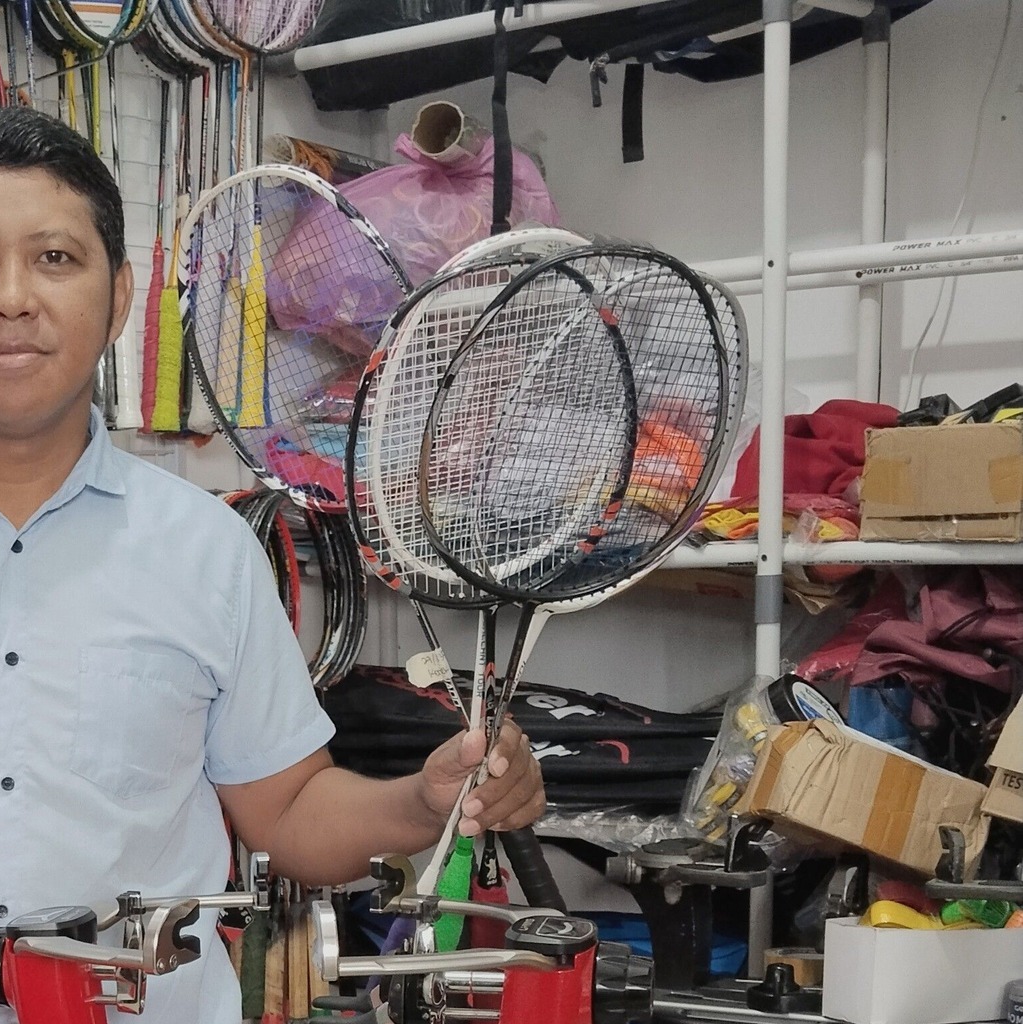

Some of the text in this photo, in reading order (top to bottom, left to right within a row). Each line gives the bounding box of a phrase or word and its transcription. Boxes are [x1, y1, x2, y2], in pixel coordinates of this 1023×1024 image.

[893, 242, 931, 251] POWER
[936, 239, 962, 247] MAX
[861, 267, 895, 276] POWER
[900, 264, 922, 272] MAX
